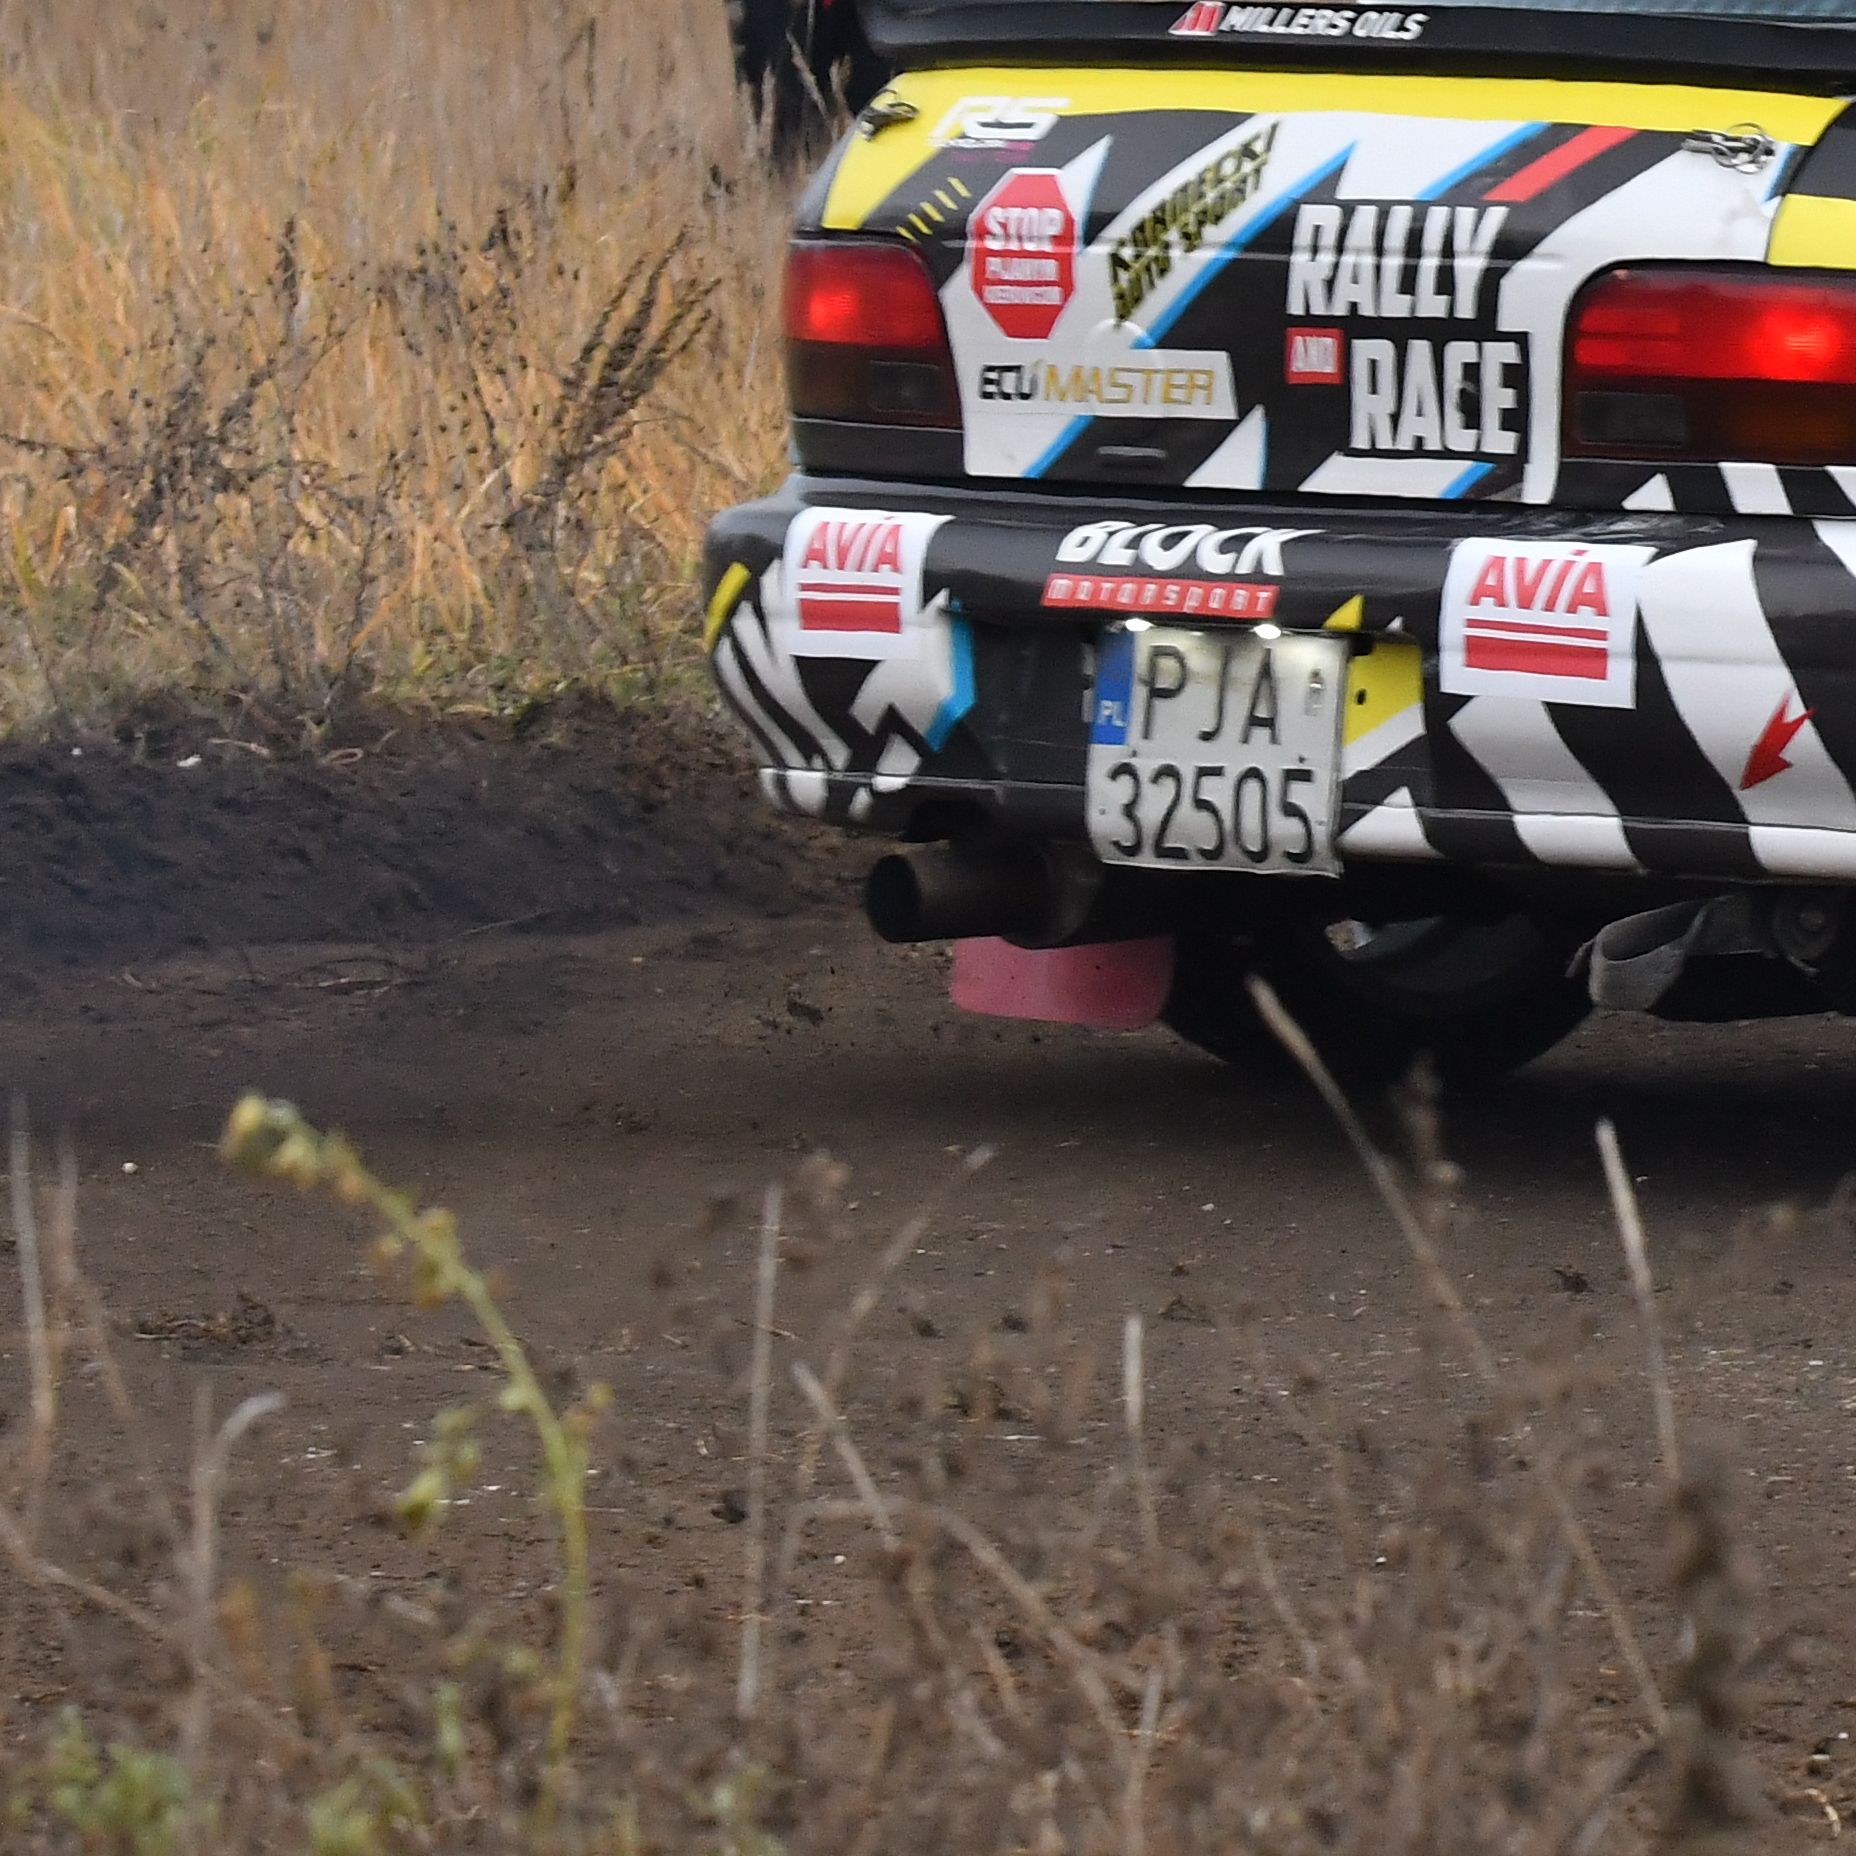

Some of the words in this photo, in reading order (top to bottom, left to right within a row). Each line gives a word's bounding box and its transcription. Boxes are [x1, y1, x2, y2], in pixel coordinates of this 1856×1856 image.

[1219, 5, 1357, 36] MILLERS
[1352, 10, 1430, 40] OILS
[928, 96, 1071, 140] RS
[982, 206, 1065, 252] STOP
[1286, 203, 1510, 320] RALLY
[979, 364, 1038, 401] ECU
[1041, 365, 1216, 405] MASTER
[1349, 338, 1523, 454] RACE
[1055, 520, 1328, 576] BLOCK
[1046, 578, 1274, 614] MOTORSPORT
[1099, 699, 1126, 727] PL
[1142, 643, 1282, 746] PJA
[1107, 762, 1315, 864] 32505
